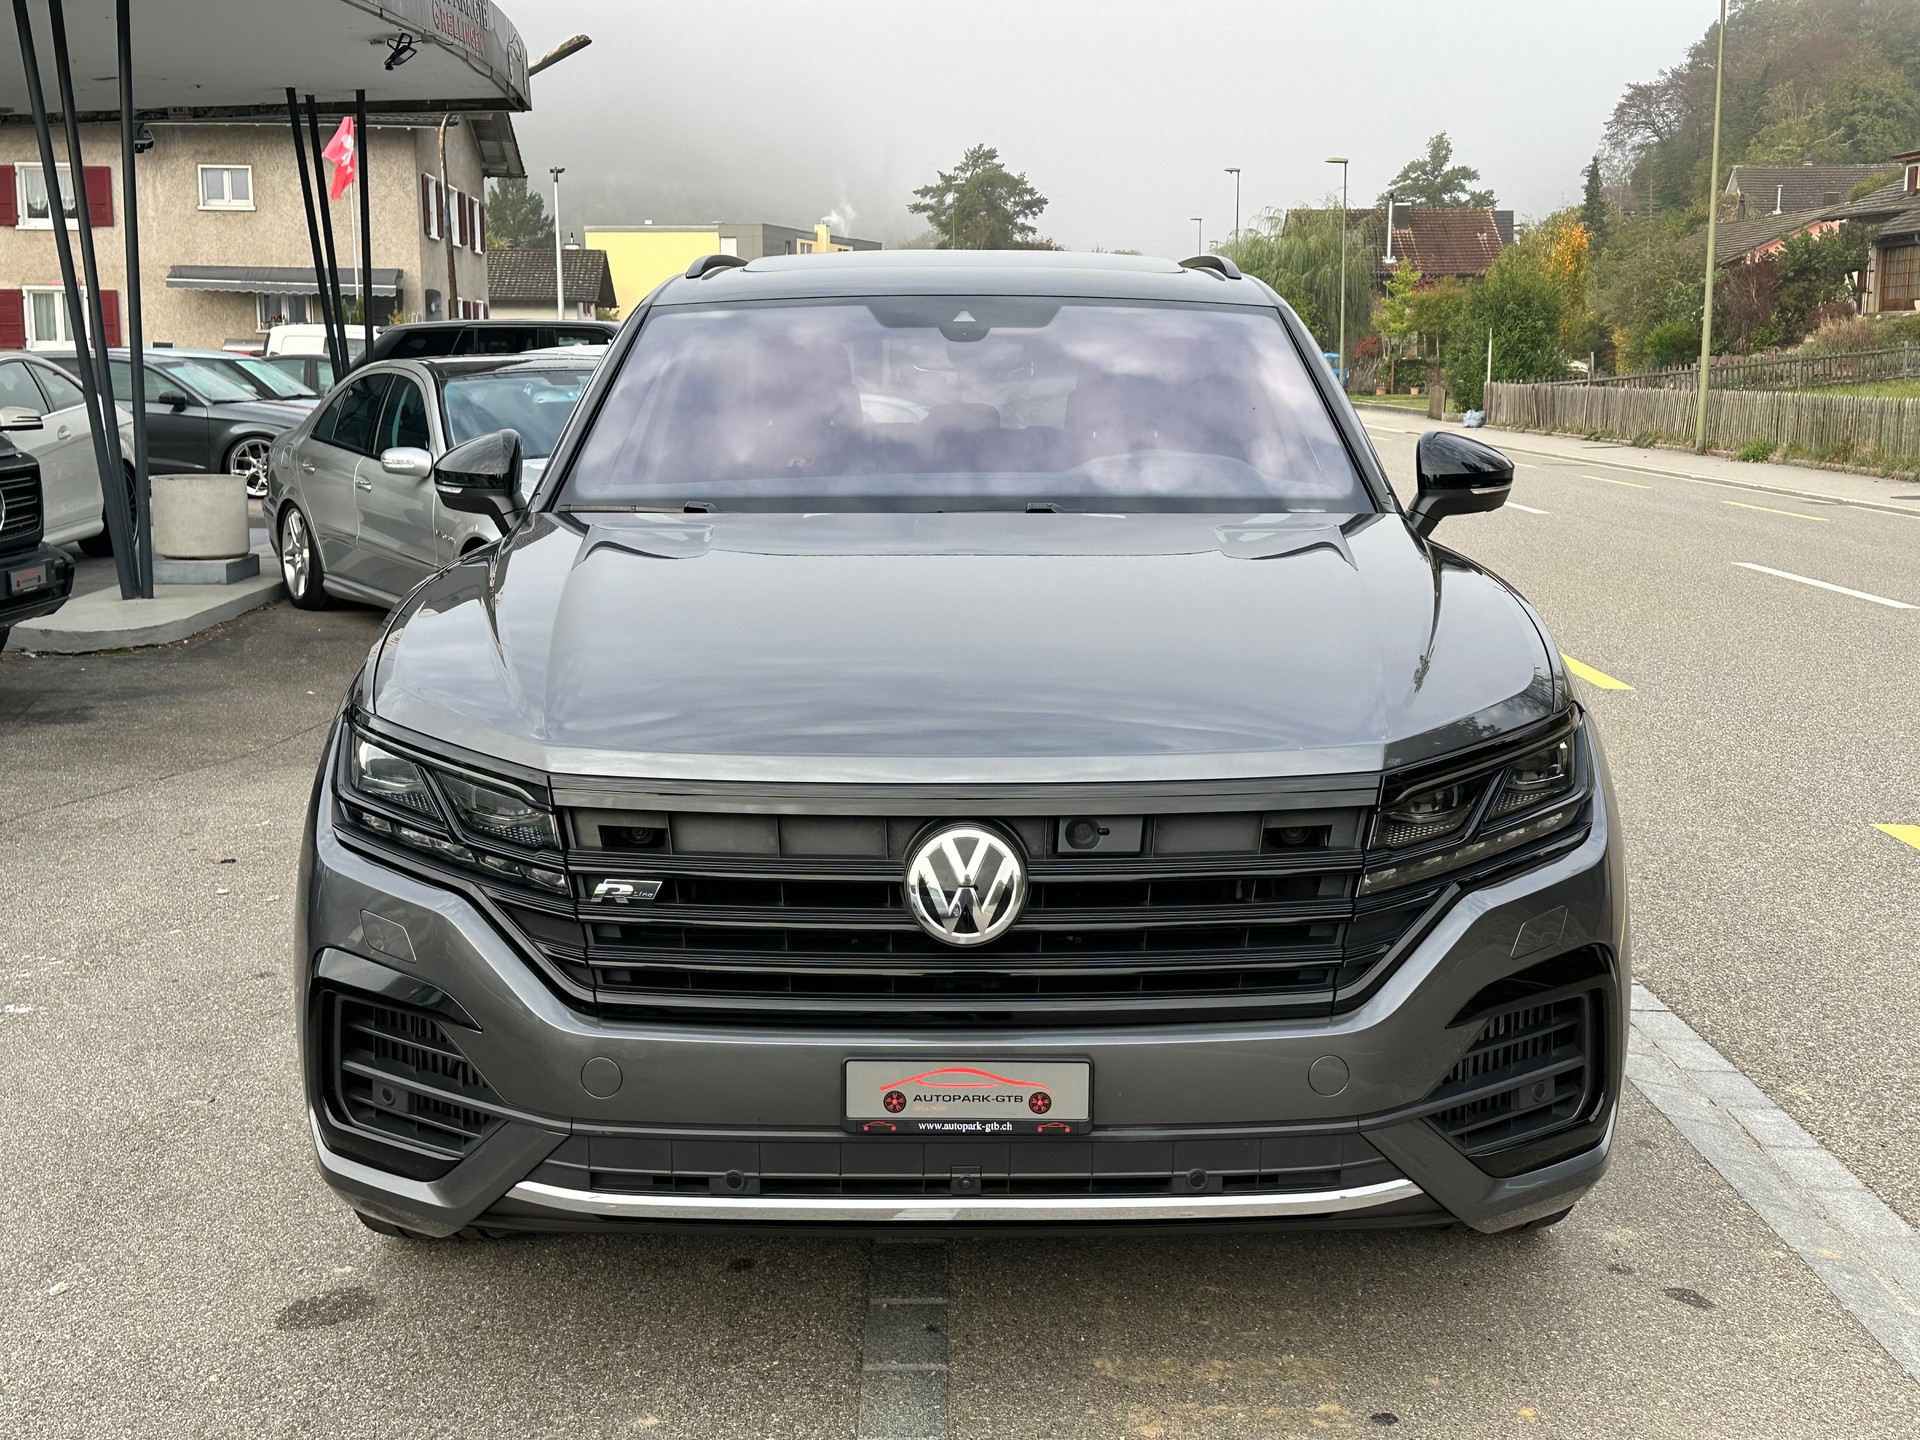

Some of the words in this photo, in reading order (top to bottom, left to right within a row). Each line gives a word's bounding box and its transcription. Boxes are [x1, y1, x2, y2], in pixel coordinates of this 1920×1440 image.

[908, 829, 1024, 943] VW
[913, 1094, 1024, 1103] AUTOPARK-GTB
[918, 1121, 1013, 1132] www.autopark-gtb.ch
